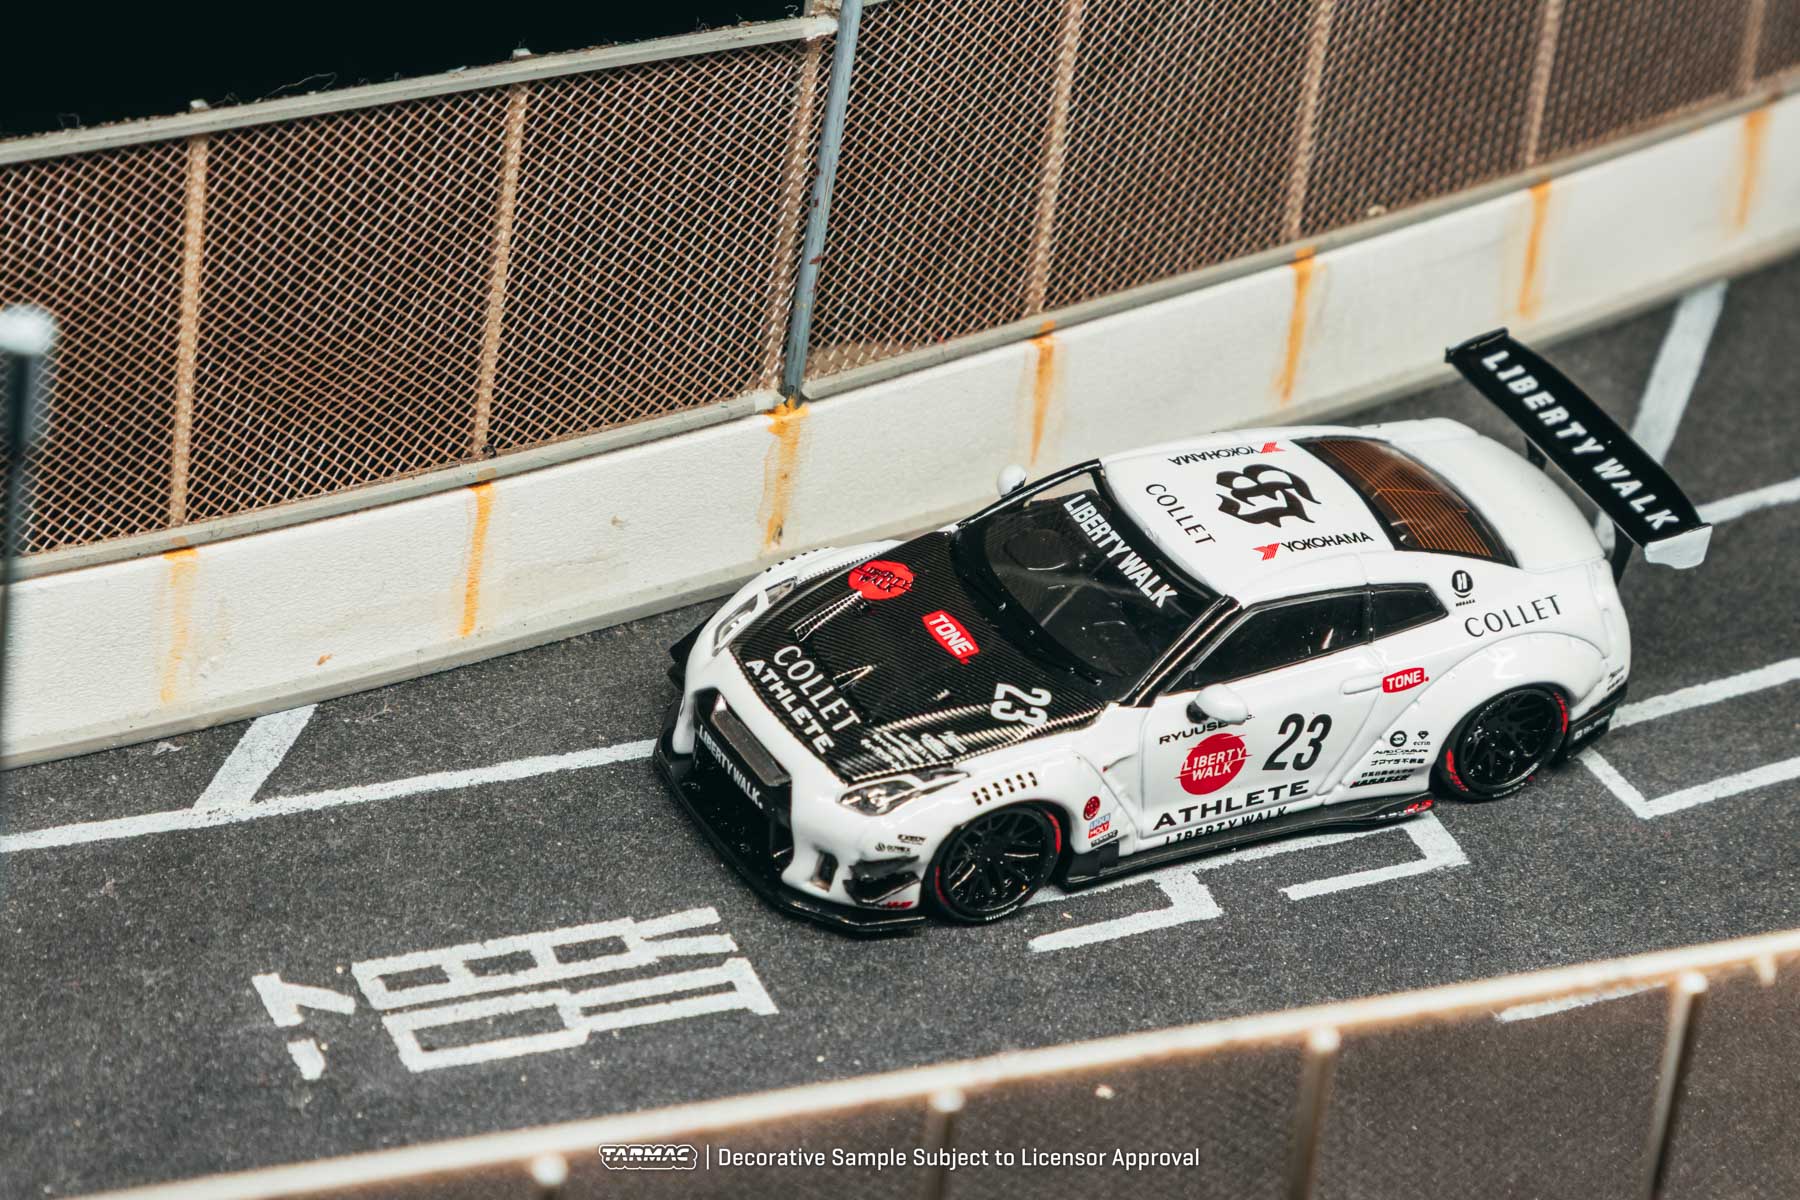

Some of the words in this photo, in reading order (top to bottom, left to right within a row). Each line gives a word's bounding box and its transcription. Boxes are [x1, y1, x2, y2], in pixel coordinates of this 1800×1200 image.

[1168, 445, 1262, 466] YOKOHAMA
[1480, 350, 1605, 457] LIBERTY
[1592, 457, 1681, 531] WALK
[1145, 483, 1216, 545] COLLET
[1063, 494, 1126, 558] LIBERTY
[1117, 547, 1173, 605] WALK
[1280, 531, 1374, 554] YOKOHAMA
[1464, 594, 1561, 638] COLLET
[746, 659, 836, 755] ATHLETE
[773, 645, 863, 732] COLLET
[991, 682, 1053, 727] 23
[699, 725, 735, 775] LIBERTY
[1182, 747, 1246, 772] LIBERTY
[1262, 713, 1333, 772] 23
[1192, 761, 1232, 782] WALK
[1153, 780, 1309, 830] ATHLETE
